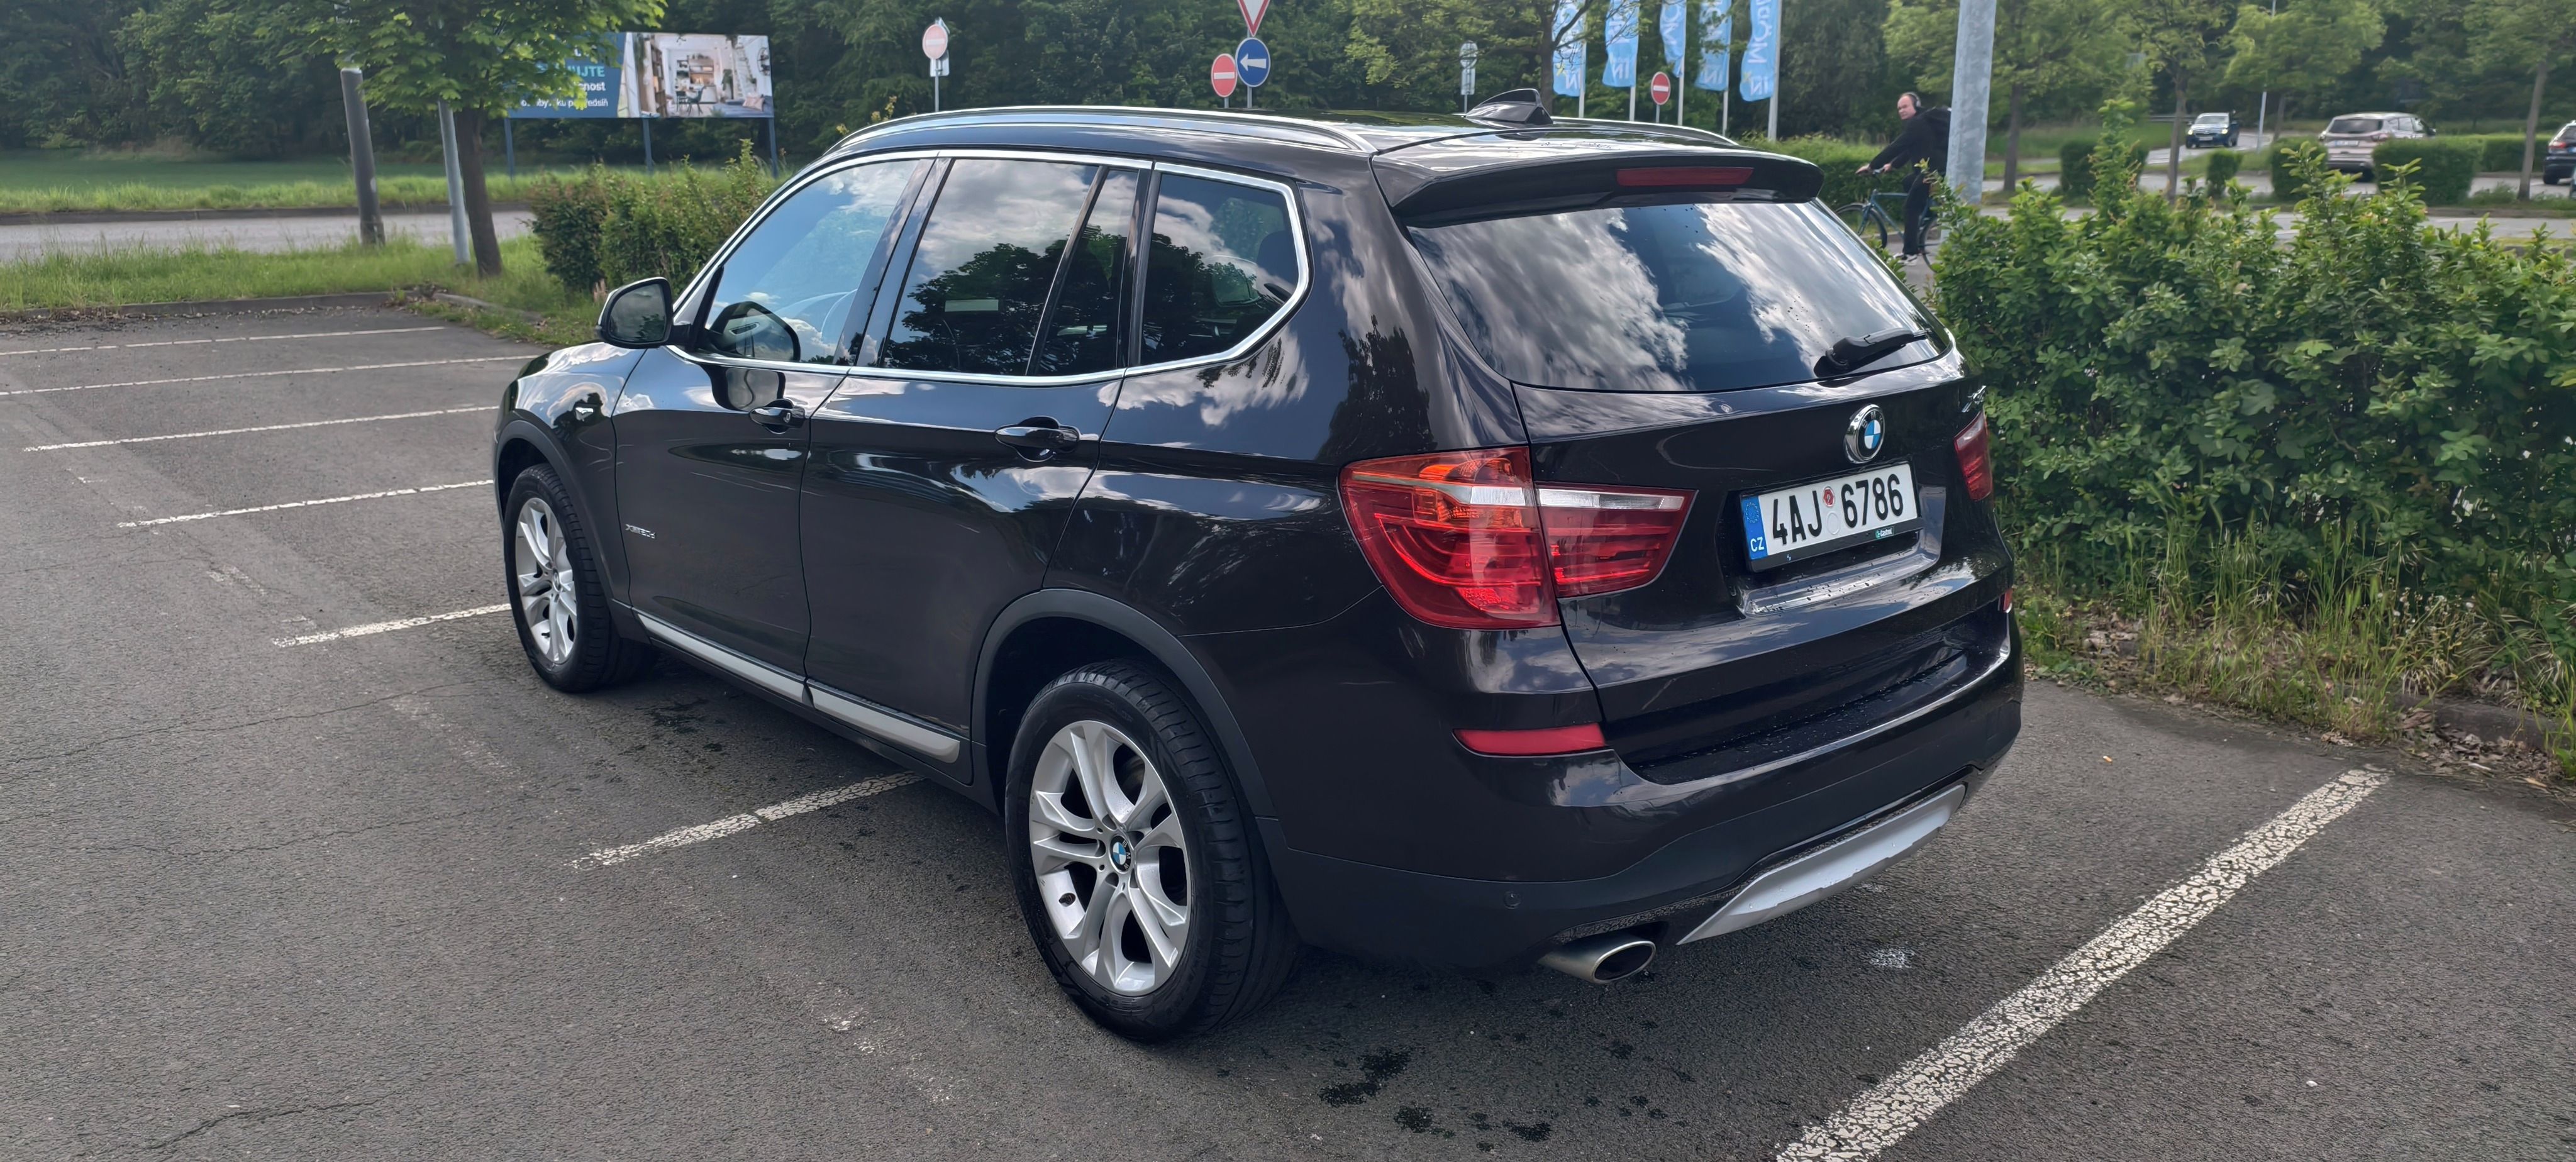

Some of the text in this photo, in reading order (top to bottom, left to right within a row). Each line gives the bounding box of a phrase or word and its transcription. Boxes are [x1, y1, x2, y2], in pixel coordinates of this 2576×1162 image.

[1772, 473, 1904, 545] 4AJ 6786
[1750, 536, 1765, 552] CZ
